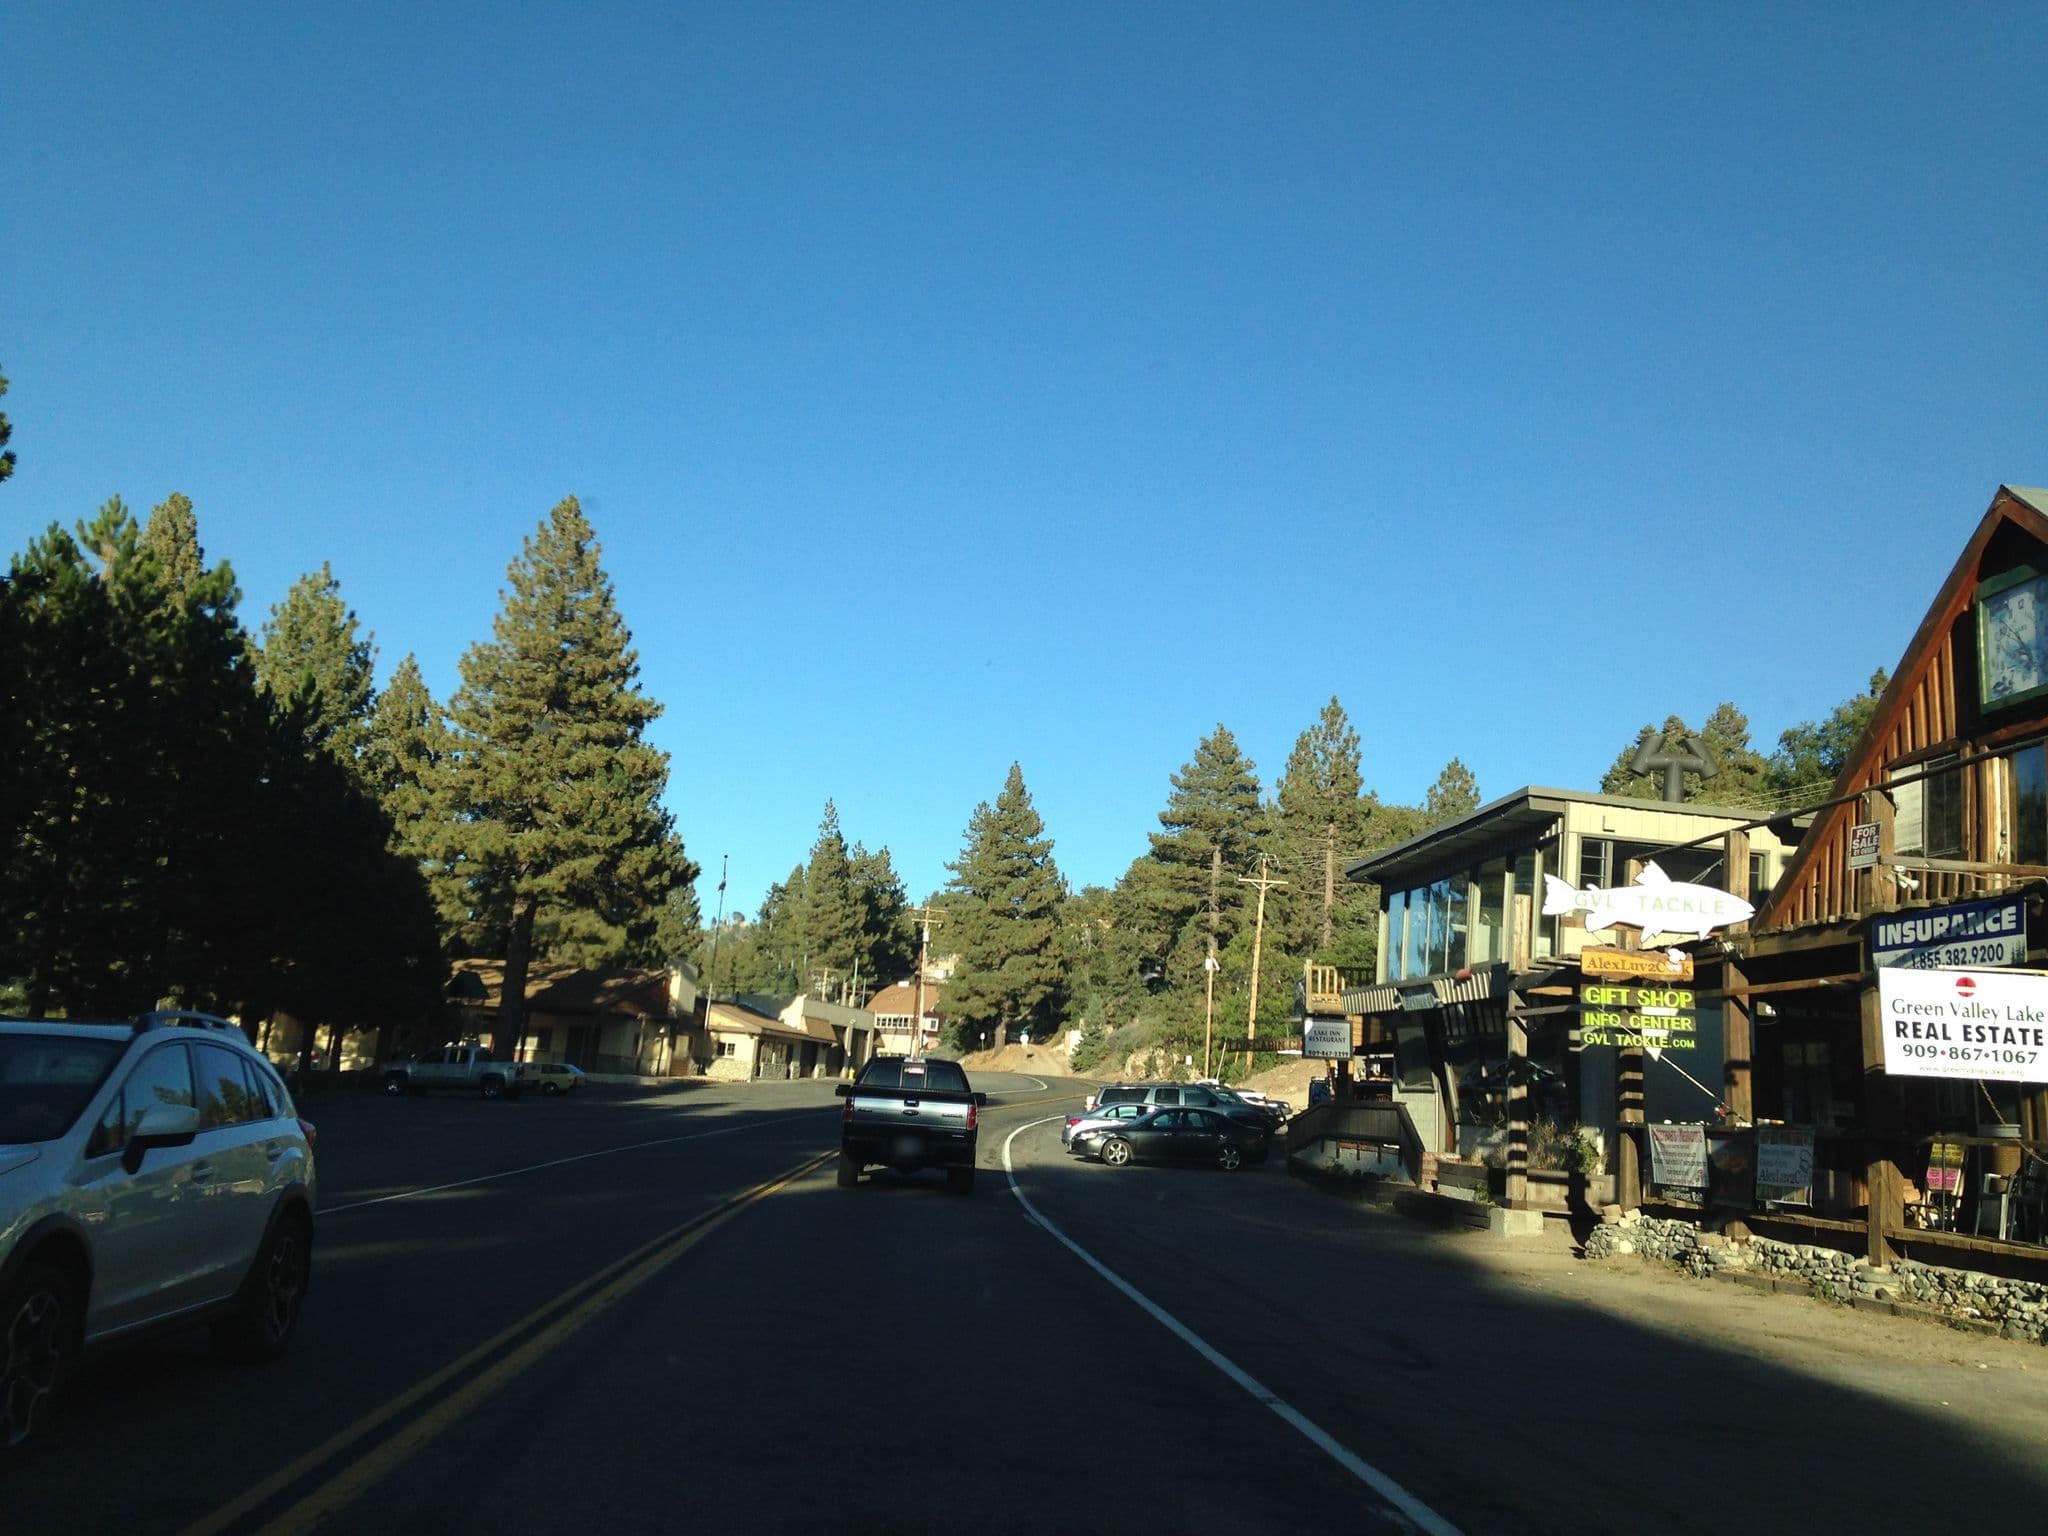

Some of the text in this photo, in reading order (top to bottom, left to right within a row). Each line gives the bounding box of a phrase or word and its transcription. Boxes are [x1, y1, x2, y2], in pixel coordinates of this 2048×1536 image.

[1852, 835, 1880, 850] SALE
[1856, 826, 1876, 839] FOR
[1574, 892, 1726, 915] GVL TACKLE
[1879, 907, 2017, 946] INSURANCE
[1587, 956, 1691, 975] AlexLuv2Ck
[1585, 987, 1693, 1008] GIFT SHOP
[1892, 998, 2045, 1023] Green Valley Lake
[1584, 1011, 1693, 1031] INFO CENTER
[1308, 1035, 1346, 1043] RESTAURANT
[1583, 1032, 1611, 1046] GVL
[1895, 1020, 2044, 1047] REAL ESTATE
